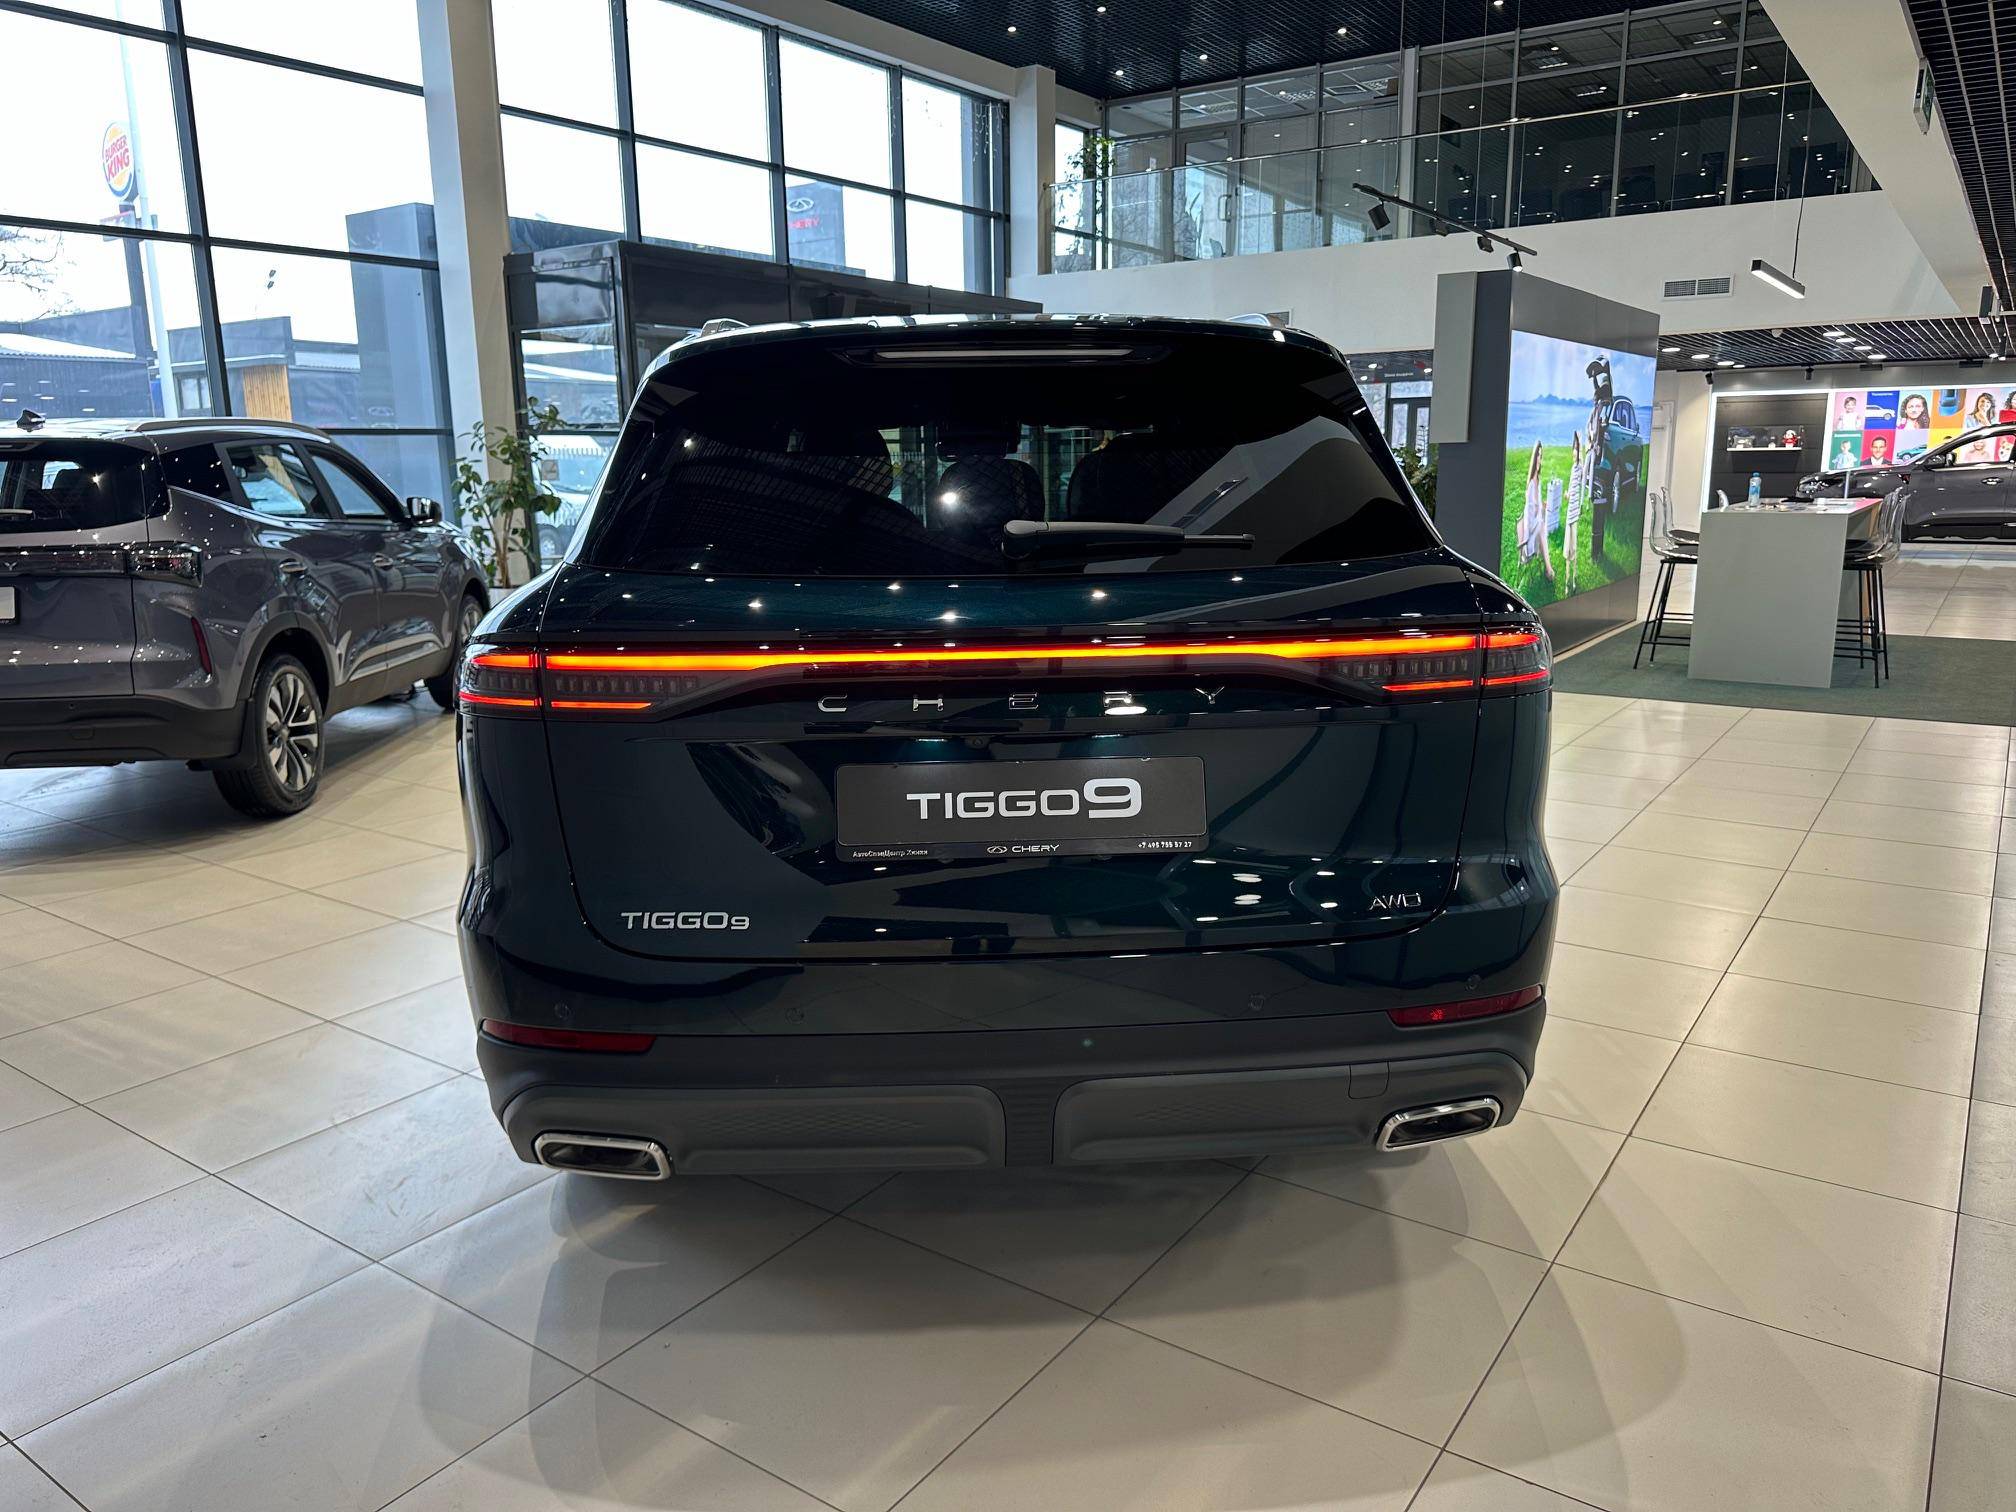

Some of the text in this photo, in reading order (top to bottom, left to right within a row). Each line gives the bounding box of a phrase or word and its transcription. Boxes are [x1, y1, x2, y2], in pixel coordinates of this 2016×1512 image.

[105, 135, 127, 162] BURGER
[107, 147, 130, 179] KING
[817, 685, 1225, 713] CHERY
[1011, 844, 1060, 853] CHERY
[1138, 841, 1147, 849] +7
[1147, 841, 1160, 849] 495
[1368, 893, 1422, 911] AWD
